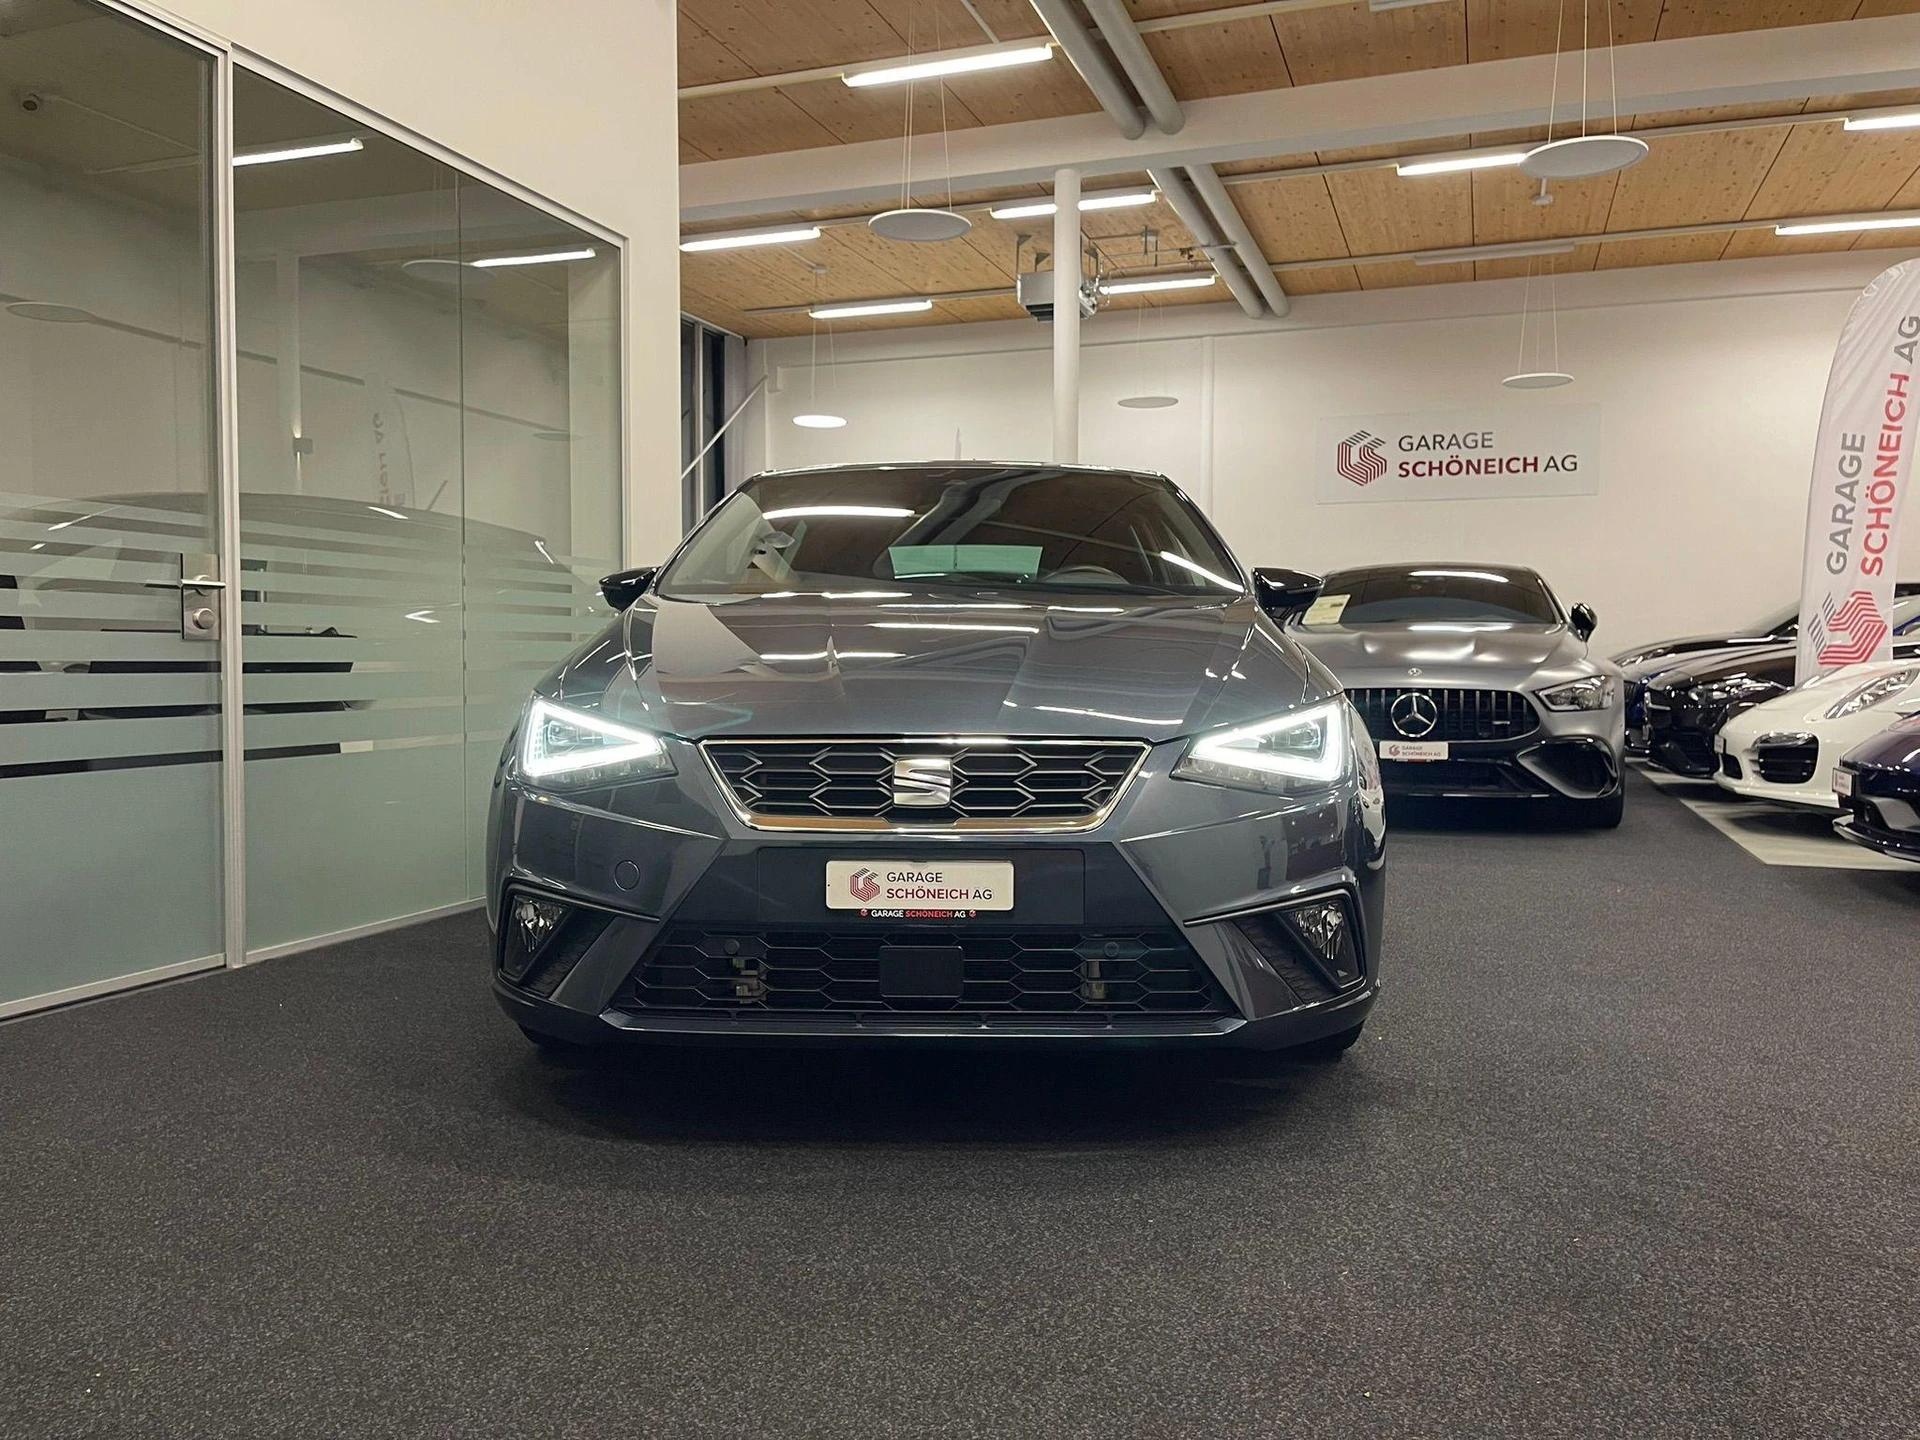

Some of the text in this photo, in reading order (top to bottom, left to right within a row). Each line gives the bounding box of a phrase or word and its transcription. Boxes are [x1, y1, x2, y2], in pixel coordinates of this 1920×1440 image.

[1398, 431, 1494, 452] GARAGE
[1860, 315, 1920, 577] SCHÖNEICH AG
[1398, 454, 1578, 478] SCHÖNEICH AG
[1826, 431, 1867, 576] GARAGE
[886, 871, 943, 883] GARAGE
[886, 885, 993, 900] SCHÖNEICH AG
[871, 909, 904, 918] GARAGE
[954, 910, 966, 918] AG
